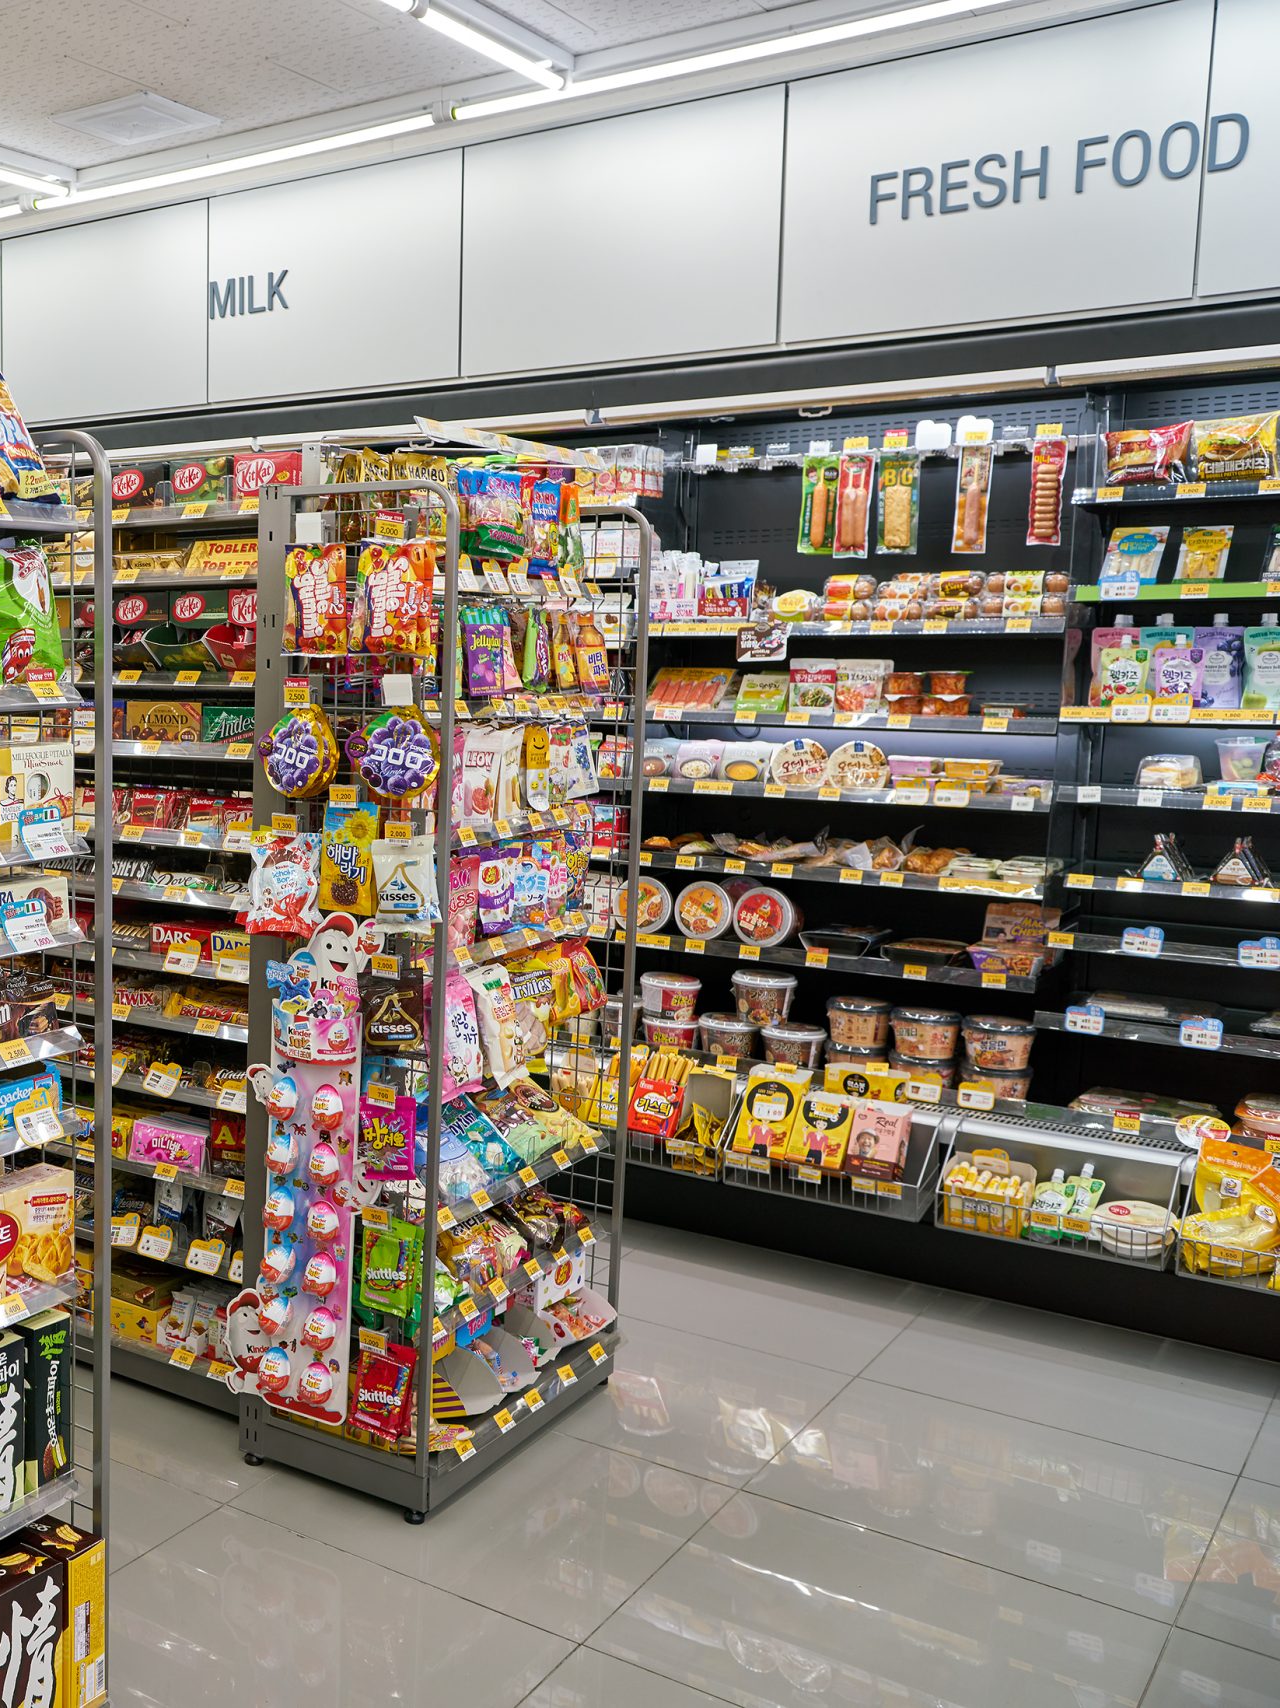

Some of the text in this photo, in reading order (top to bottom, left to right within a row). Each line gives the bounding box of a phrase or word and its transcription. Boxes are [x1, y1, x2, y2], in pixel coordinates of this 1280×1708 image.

[869, 112, 1250, 225] FRESH FOOD
[207, 269, 289, 320] MILK
[179, 466, 204, 489] KitKat
[241, 463, 272, 487] KitKat
[409, 467, 445, 483] HARIBO
[113, 474, 140, 496] KitKat
[378, 513, 393, 521] New
[380, 527, 399, 536] 2,000
[386, 555, 409, 612] Smile
[118, 599, 145, 621] KitKat
[176, 597, 202, 619] KitKat
[588, 653, 603, 665] 비타
[29, 671, 43, 680] New
[288, 692, 306, 701] 2,500
[139, 713, 189, 725] ALMOND
[214, 715, 255, 738] Andes
[370, 744, 423, 770] コロロ
[191, 797, 214, 806] Loacker
[335, 792, 352, 801] 1,200
[277, 822, 292, 830] 1,300
[390, 830, 407, 839] 2,000
[327, 843, 359, 863] 해바
[340, 861, 367, 886] 라기
[379, 892, 417, 902] KISSES
[377, 962, 394, 971] 2,000
[370, 1024, 413, 1034] KISSES
[980, 1040, 1007, 1051] 볶음면
[7, 1048, 26, 1059] 2,500
[377, 1091, 389, 1100] 700
[637, 1097, 673, 1116] 키스틱
[876, 1115, 899, 1130] Real
[371, 1213, 382, 1222] 900
[366, 1266, 407, 1282] Skittles
[363, 1339, 379, 1348] 1,000
[358, 1388, 402, 1407] Skittles
